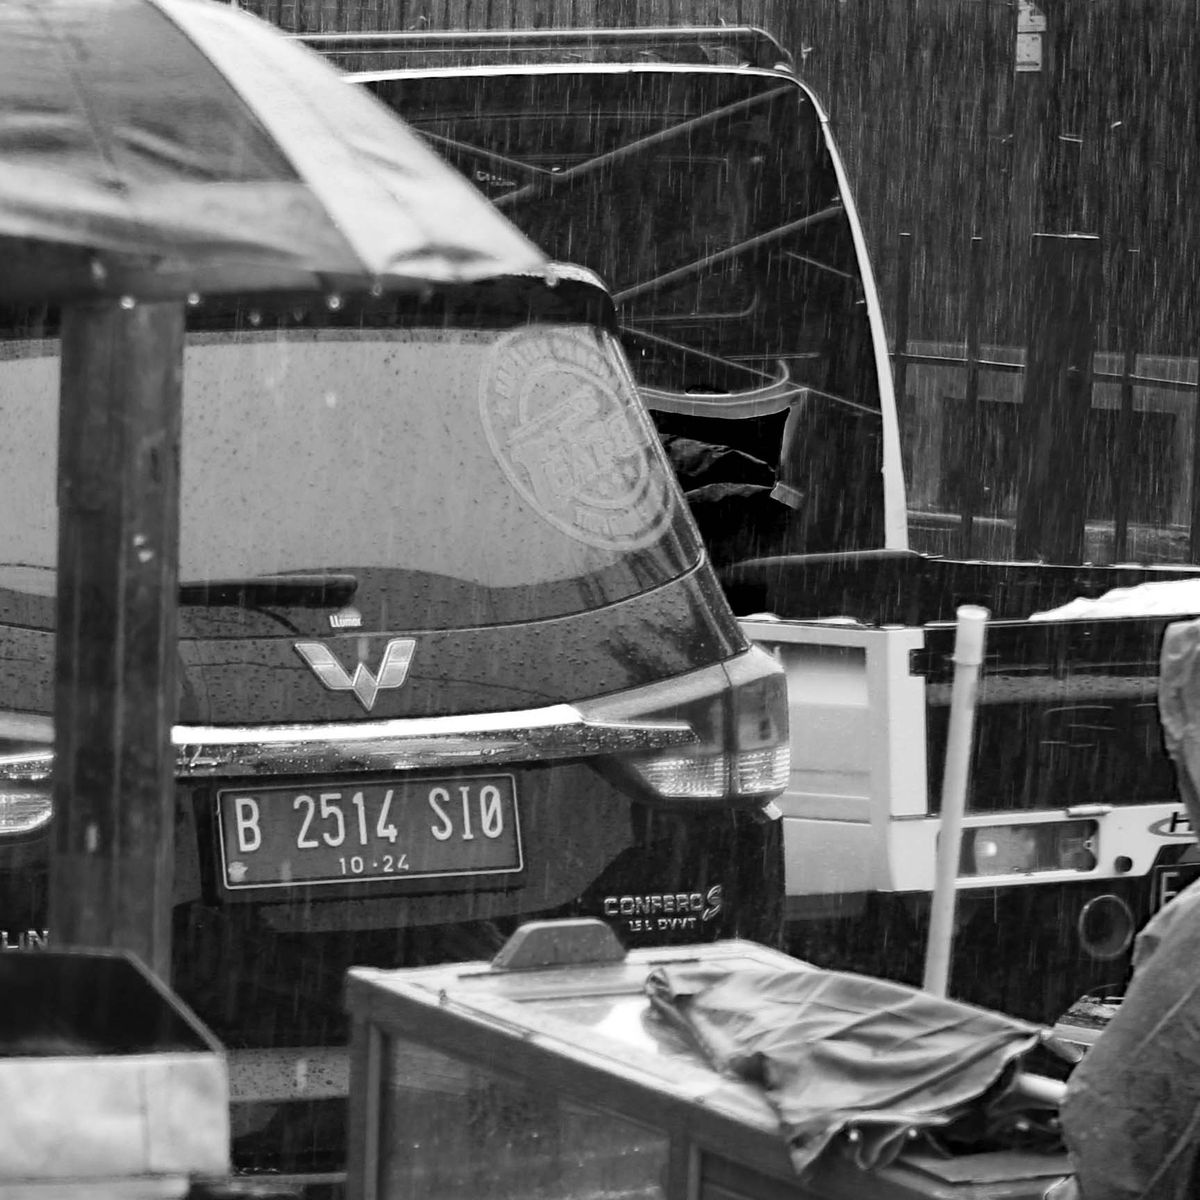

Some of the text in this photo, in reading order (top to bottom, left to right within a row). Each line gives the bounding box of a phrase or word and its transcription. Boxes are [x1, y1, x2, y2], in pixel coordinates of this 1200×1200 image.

[234, 797, 262, 853] B
[293, 789, 398, 849] 2514
[603, 893, 704, 916] CONFERO
